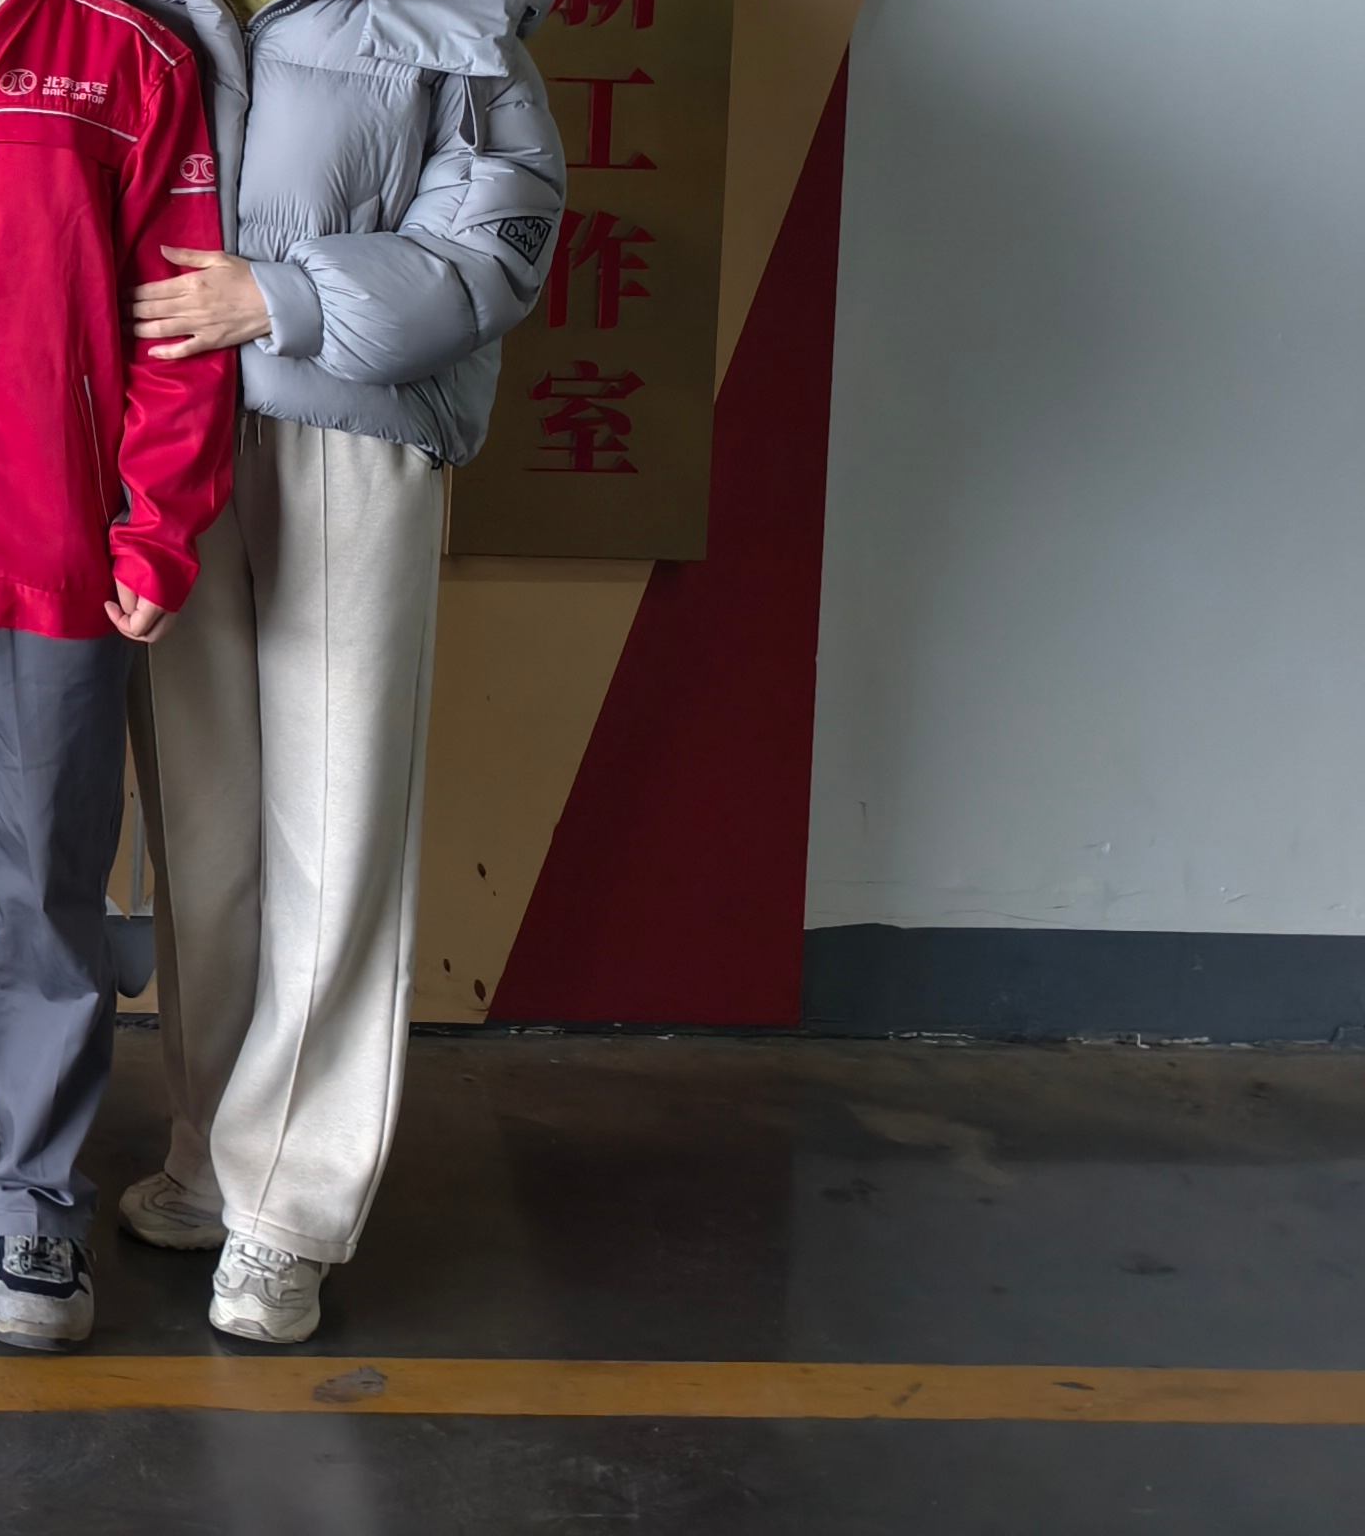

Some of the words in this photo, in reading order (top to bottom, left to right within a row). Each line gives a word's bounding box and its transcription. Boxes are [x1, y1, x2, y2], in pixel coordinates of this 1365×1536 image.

[42, 88, 67, 97] BAIC
[43, 76, 108, 95] 北京汽车
